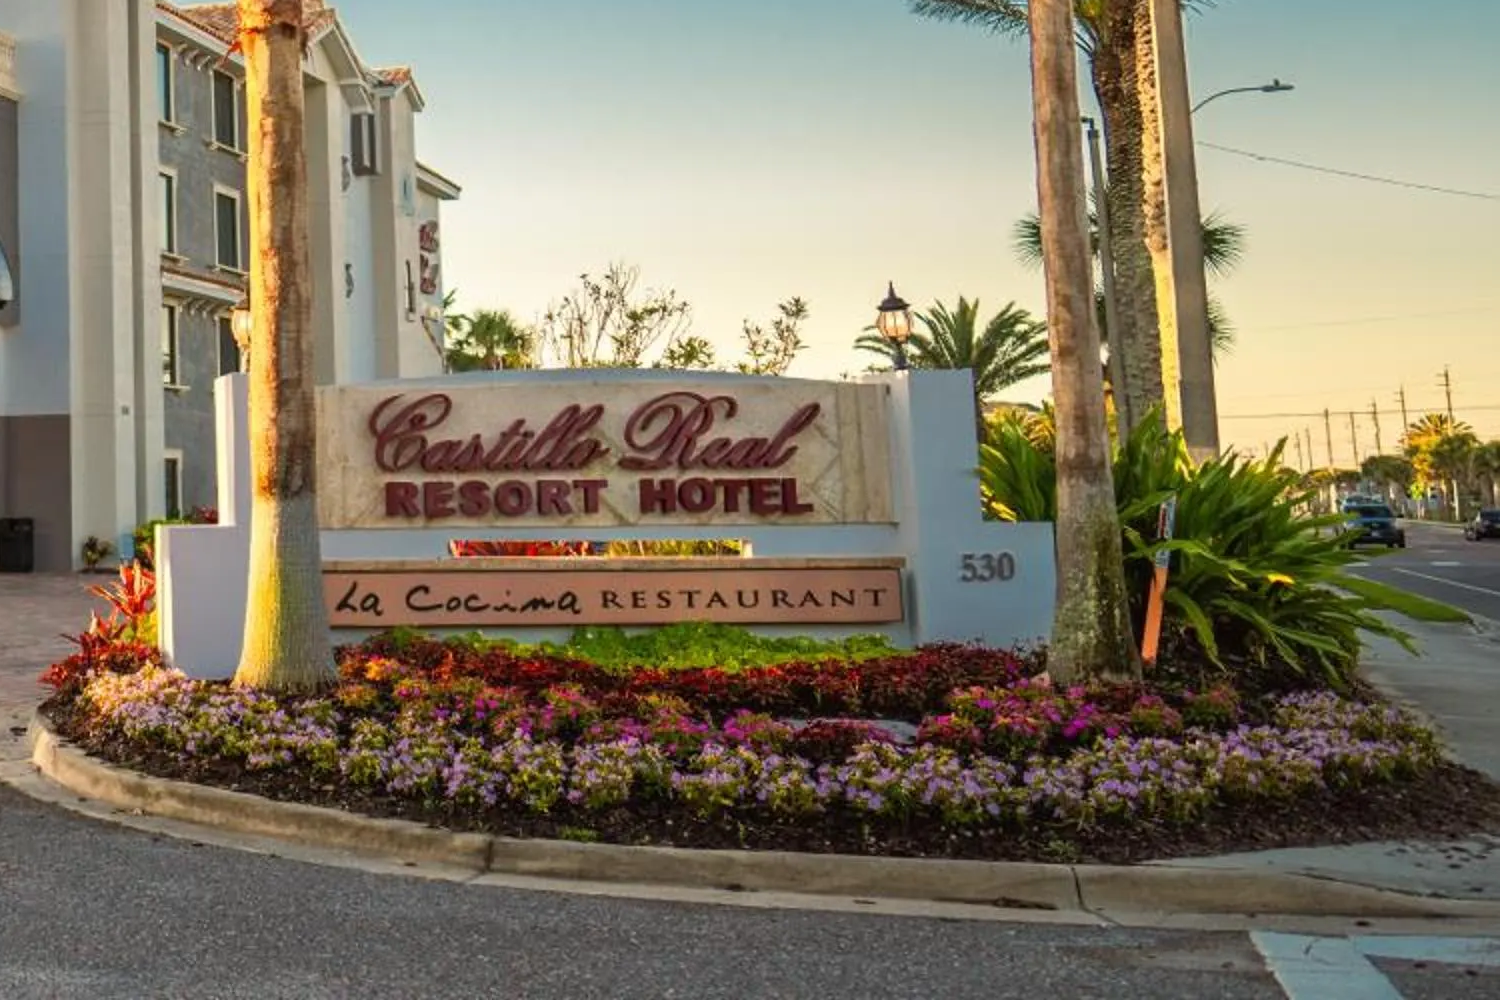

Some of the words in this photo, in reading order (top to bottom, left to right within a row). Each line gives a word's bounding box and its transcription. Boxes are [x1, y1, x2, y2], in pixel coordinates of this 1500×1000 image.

[369, 393, 611, 472] Castillo
[617, 391, 821, 470] Real
[384, 479, 608, 518] RESORT
[639, 477, 814, 516] HOTEL
[960, 551, 1015, 582] 530
[335, 581, 383, 616] La
[405, 584, 582, 615] Cocina
[601, 587, 888, 610] RESTAURANT
